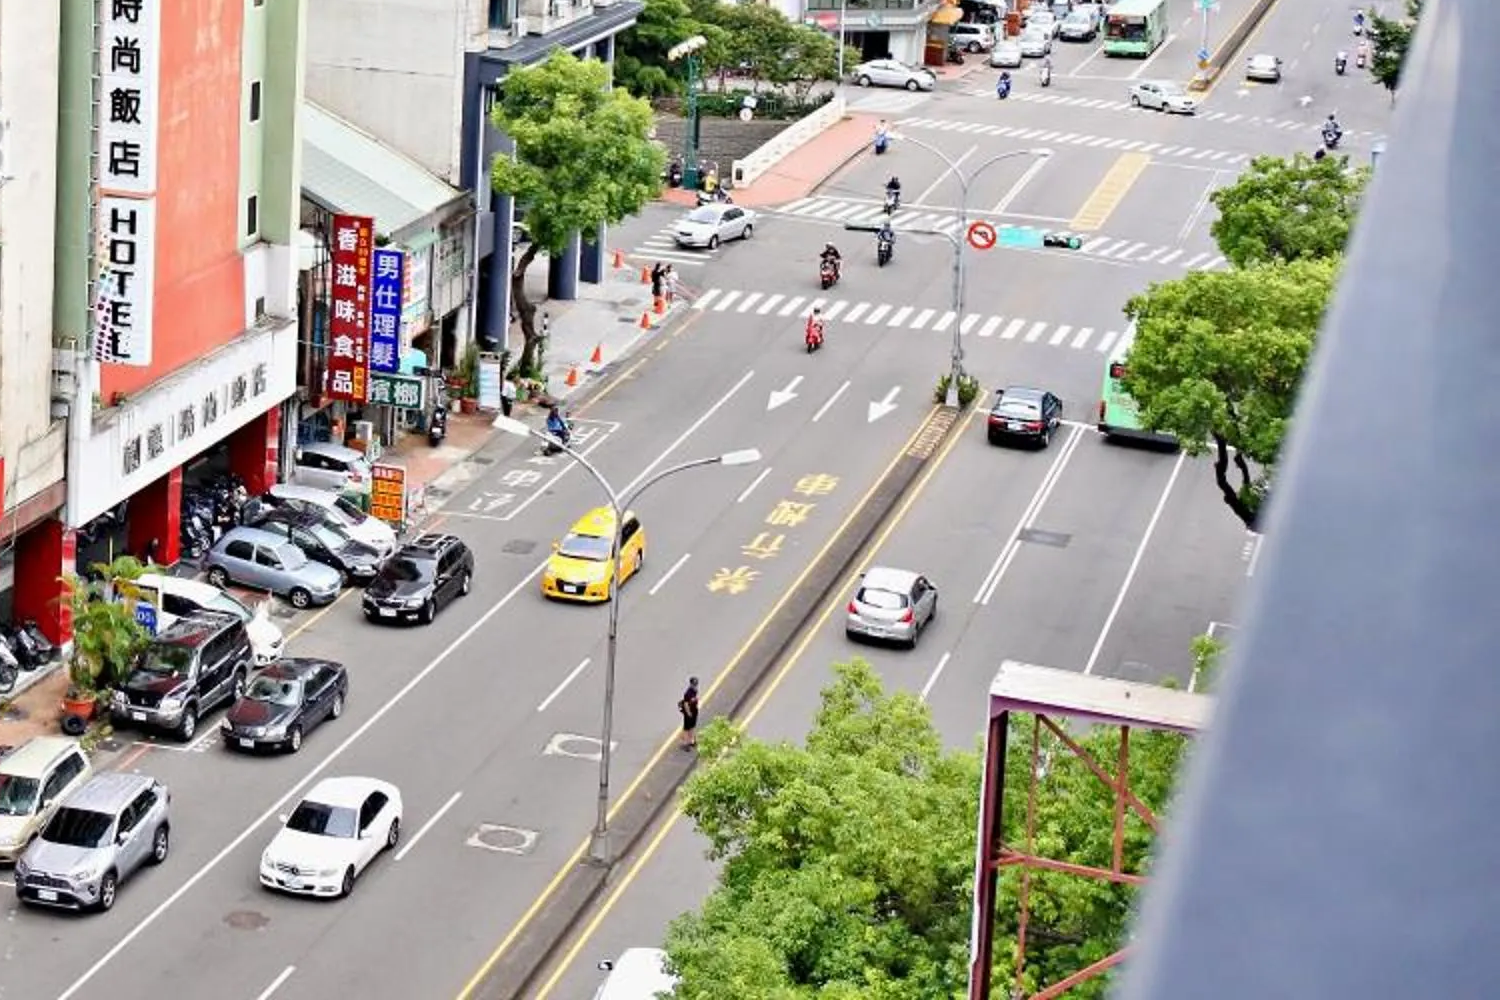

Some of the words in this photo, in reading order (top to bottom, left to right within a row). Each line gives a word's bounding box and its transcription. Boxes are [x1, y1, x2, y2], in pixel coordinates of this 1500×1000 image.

[109, 207, 137, 359] HOTEL
[333, 227, 358, 393] 香滋味食品
[371, 254, 399, 368] 男仕理髮
